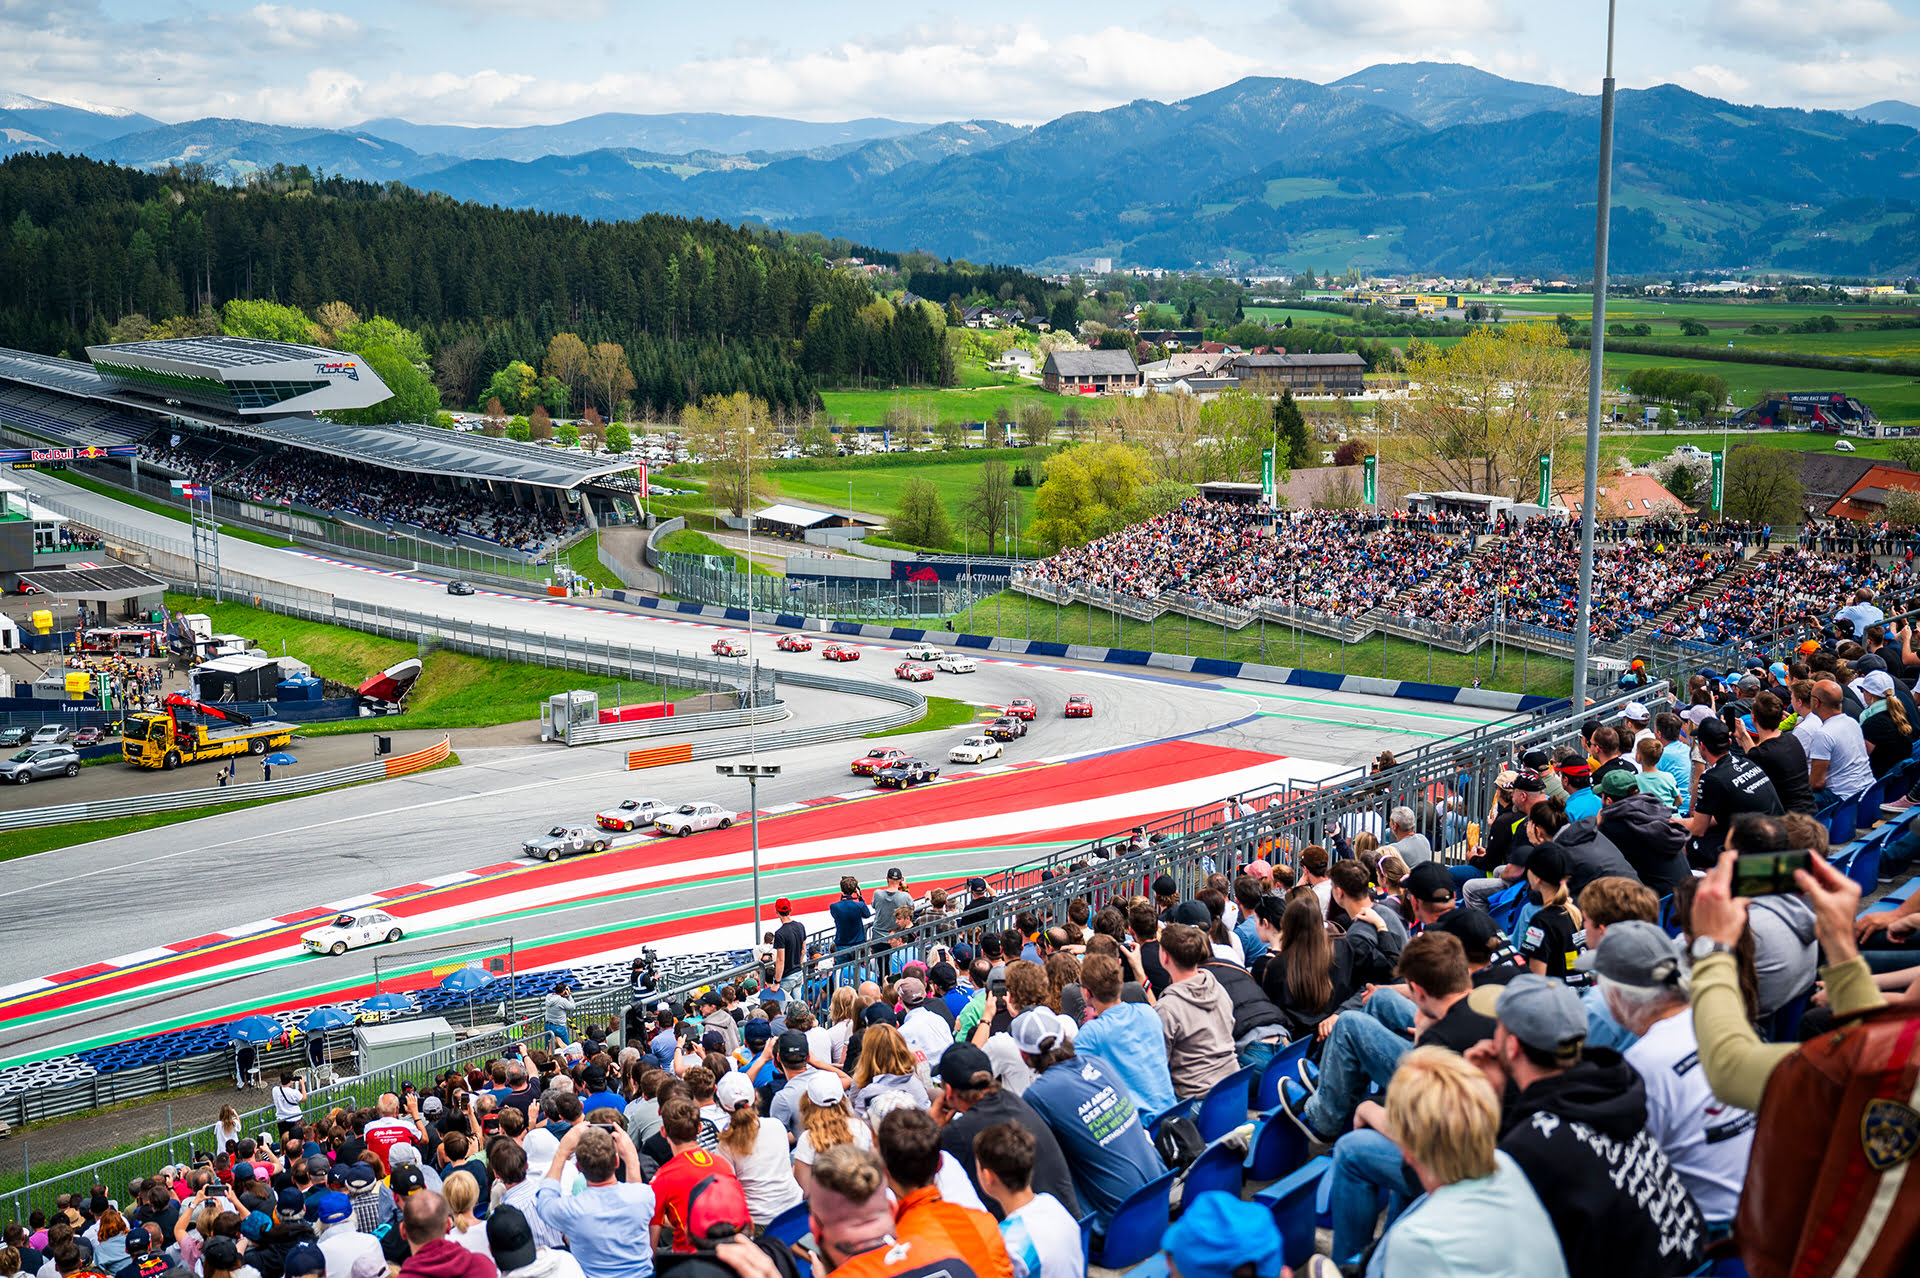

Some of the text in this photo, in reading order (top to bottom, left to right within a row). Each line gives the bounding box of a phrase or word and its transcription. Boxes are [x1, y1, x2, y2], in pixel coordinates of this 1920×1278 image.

[32, 449, 73, 460] Red Bull
[1082, 1106, 1102, 1124] DER
[1100, 1093, 1118, 1111] WELT
[1093, 1125, 1110, 1140] EIN
[140, 1262, 168, 1277] Red Bull
